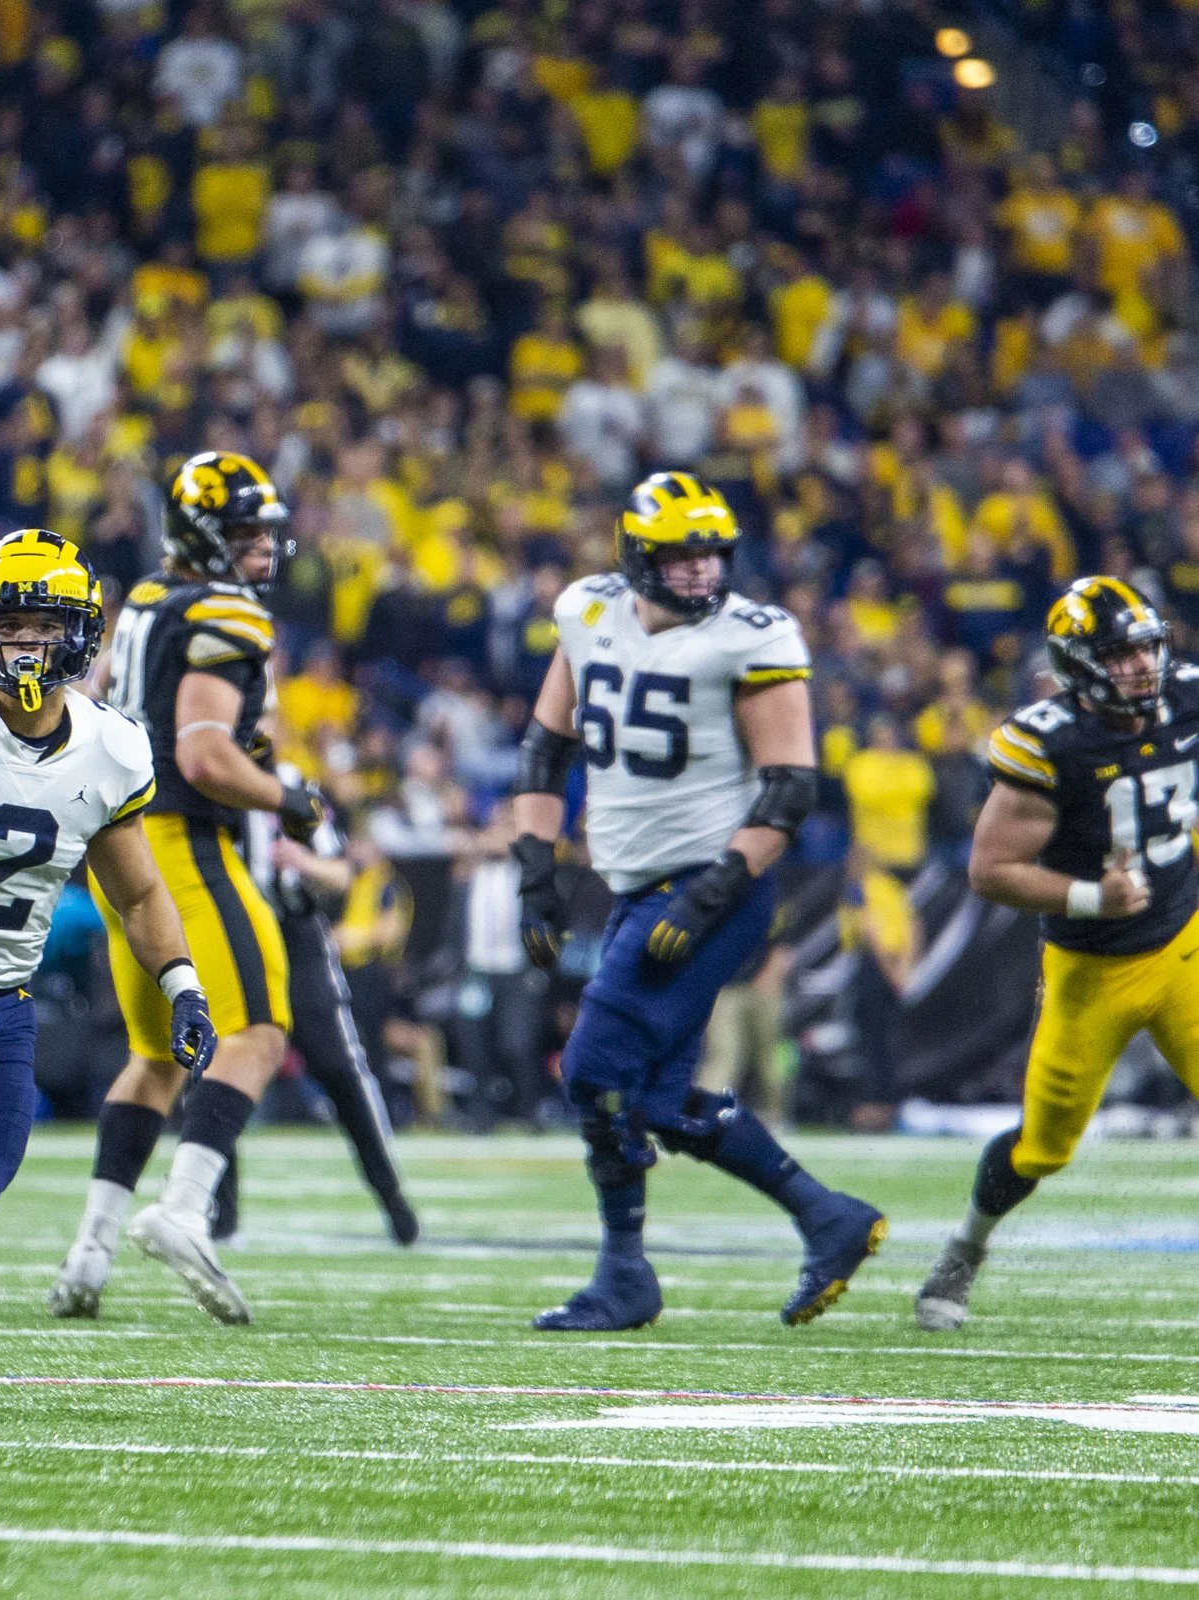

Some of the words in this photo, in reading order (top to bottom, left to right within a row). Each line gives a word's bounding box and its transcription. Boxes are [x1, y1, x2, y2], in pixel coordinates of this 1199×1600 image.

[17, 581, 33, 593] M
[577, 660, 691, 781] 65
[1104, 760, 1199, 870] 13
